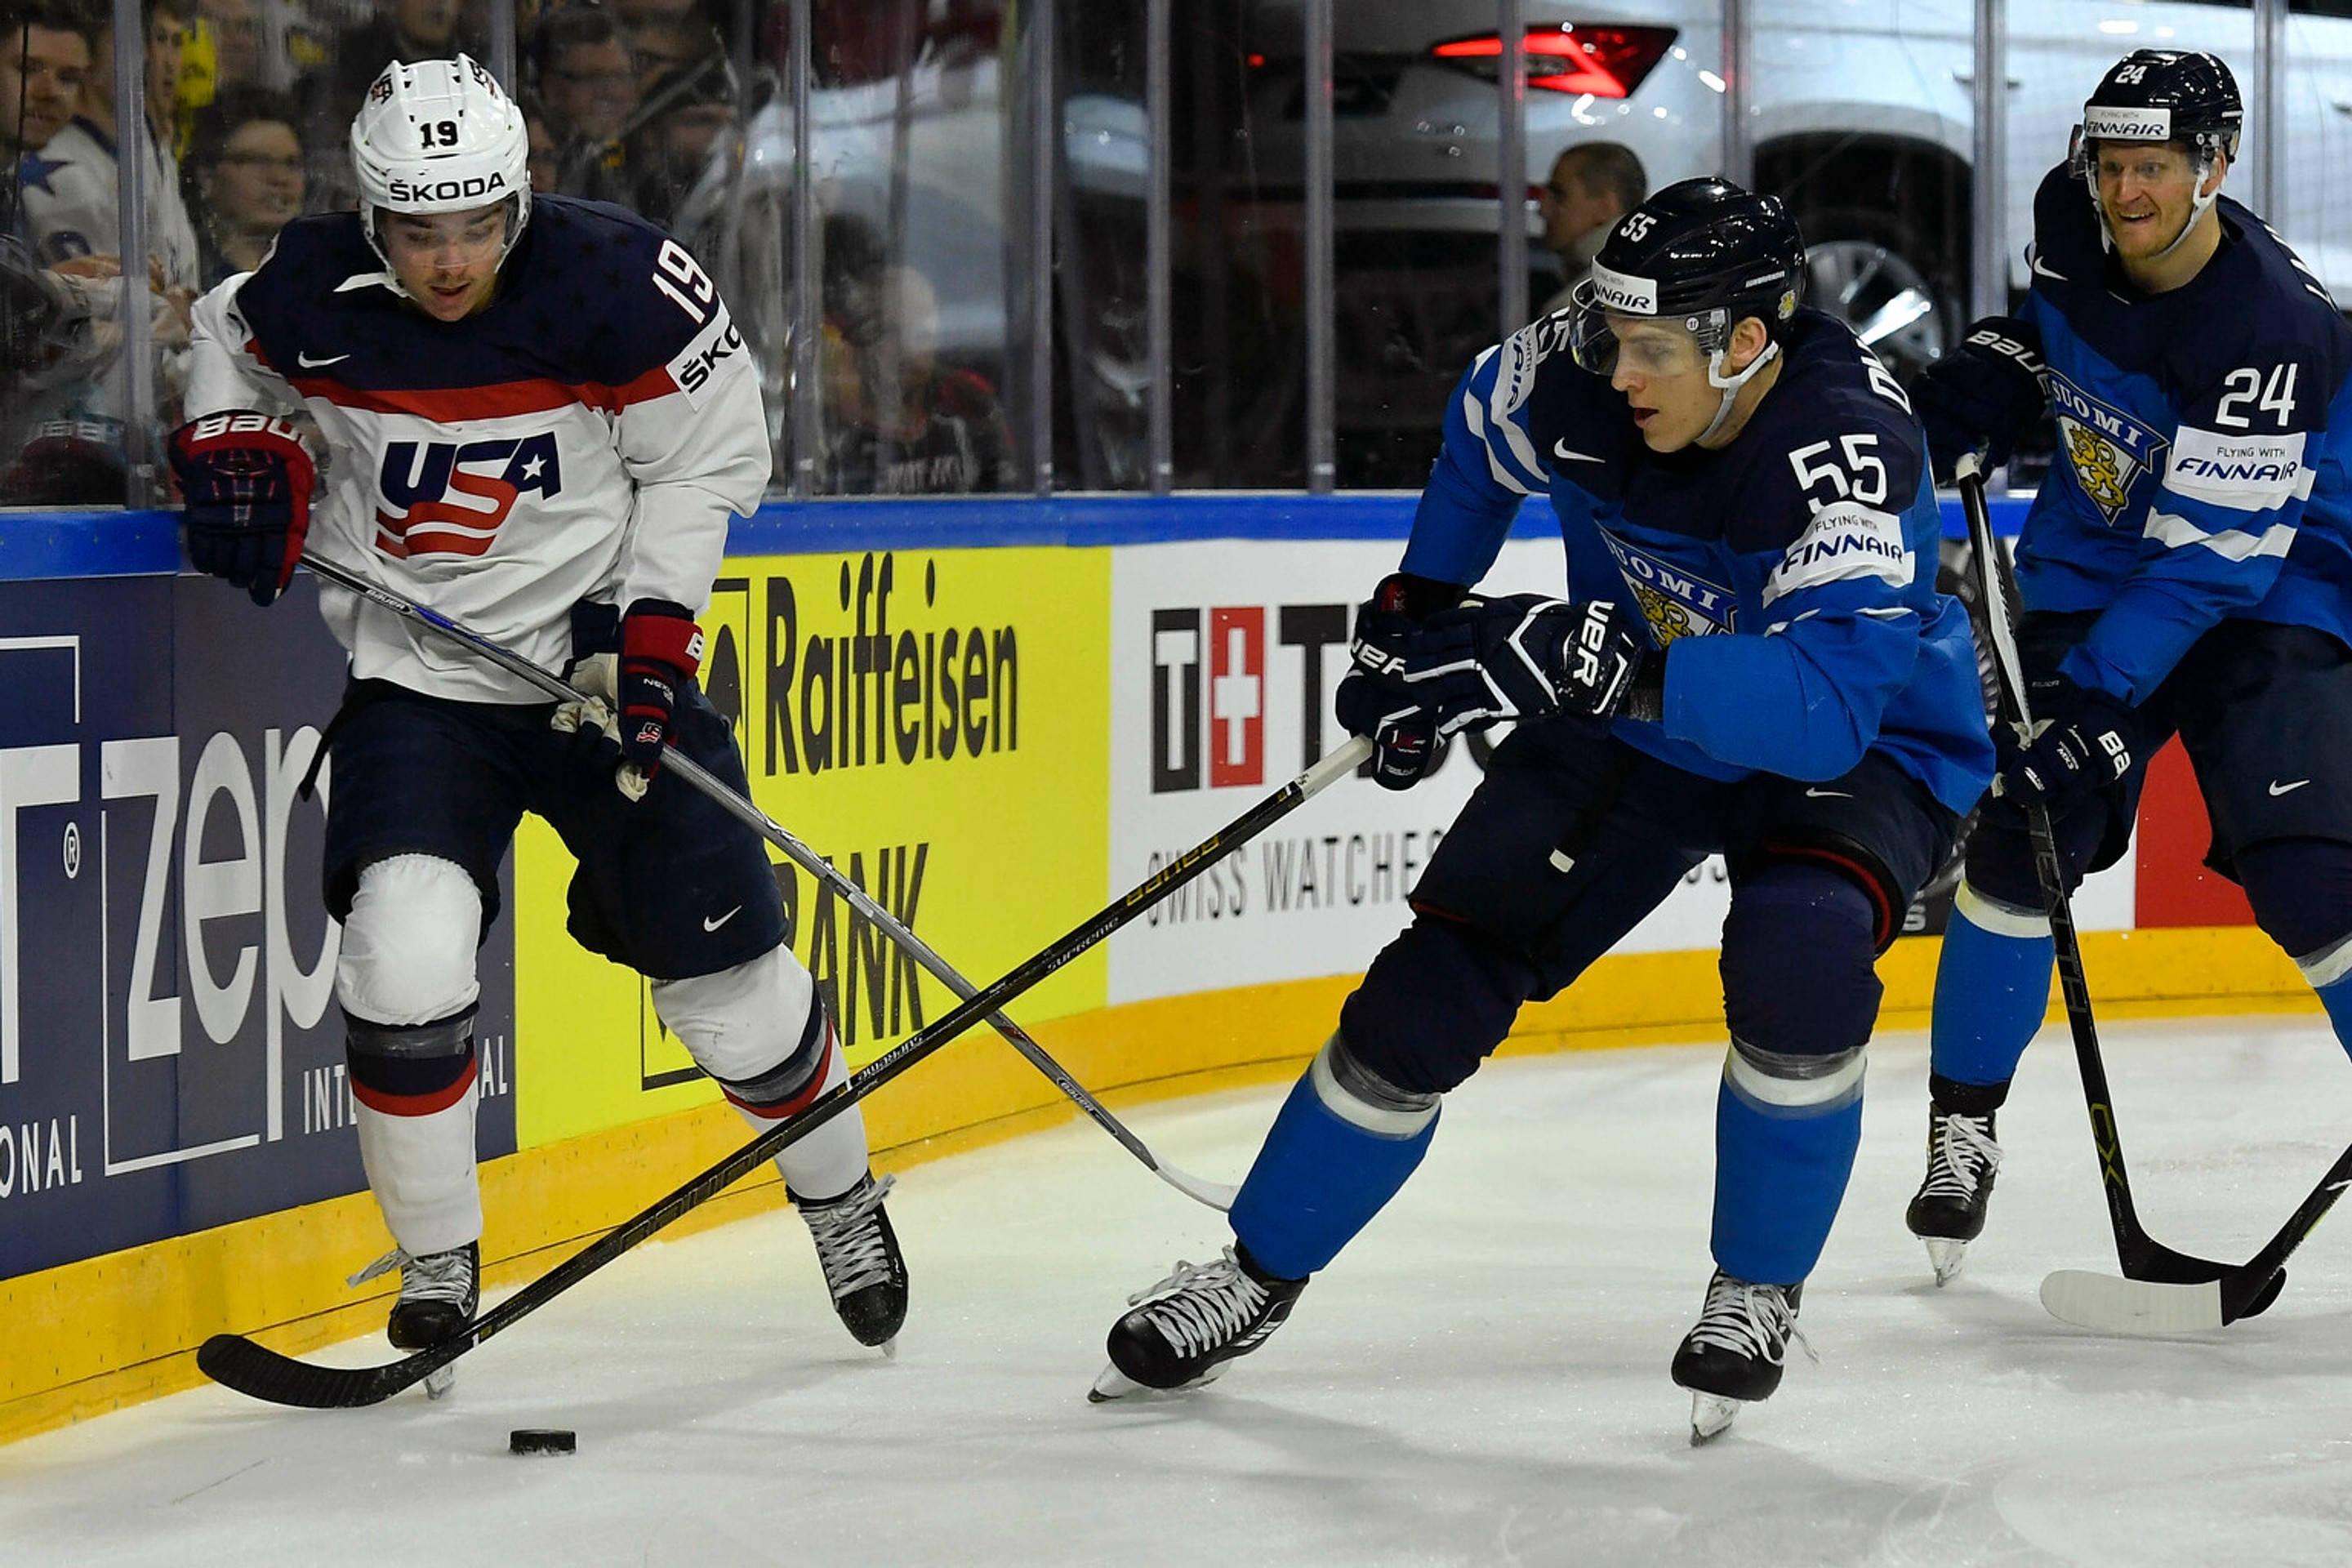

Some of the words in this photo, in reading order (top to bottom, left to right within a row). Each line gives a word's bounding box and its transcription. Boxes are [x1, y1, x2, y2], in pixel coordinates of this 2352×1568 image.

[2115, 65, 2148, 85] 24
[420, 121, 458, 149] 19
[2087, 121, 2165, 136] FINNAIR
[389, 172, 506, 203] ŠKODA
[1620, 212, 1657, 243] 55
[653, 239, 714, 325] 19
[2216, 363, 2298, 428] 24
[2051, 379, 2143, 448] SUOMI
[2216, 447, 2255, 458] FLYING
[2259, 447, 2286, 457] WITH
[1788, 434, 1888, 514] 55
[2175, 457, 2298, 482] FINNAIR
[376, 431, 561, 560] USA
[1815, 515, 1859, 532] FLYING
[1780, 535, 1904, 575] FINNAIR
[765, 552, 1018, 776] Raiffeisen
